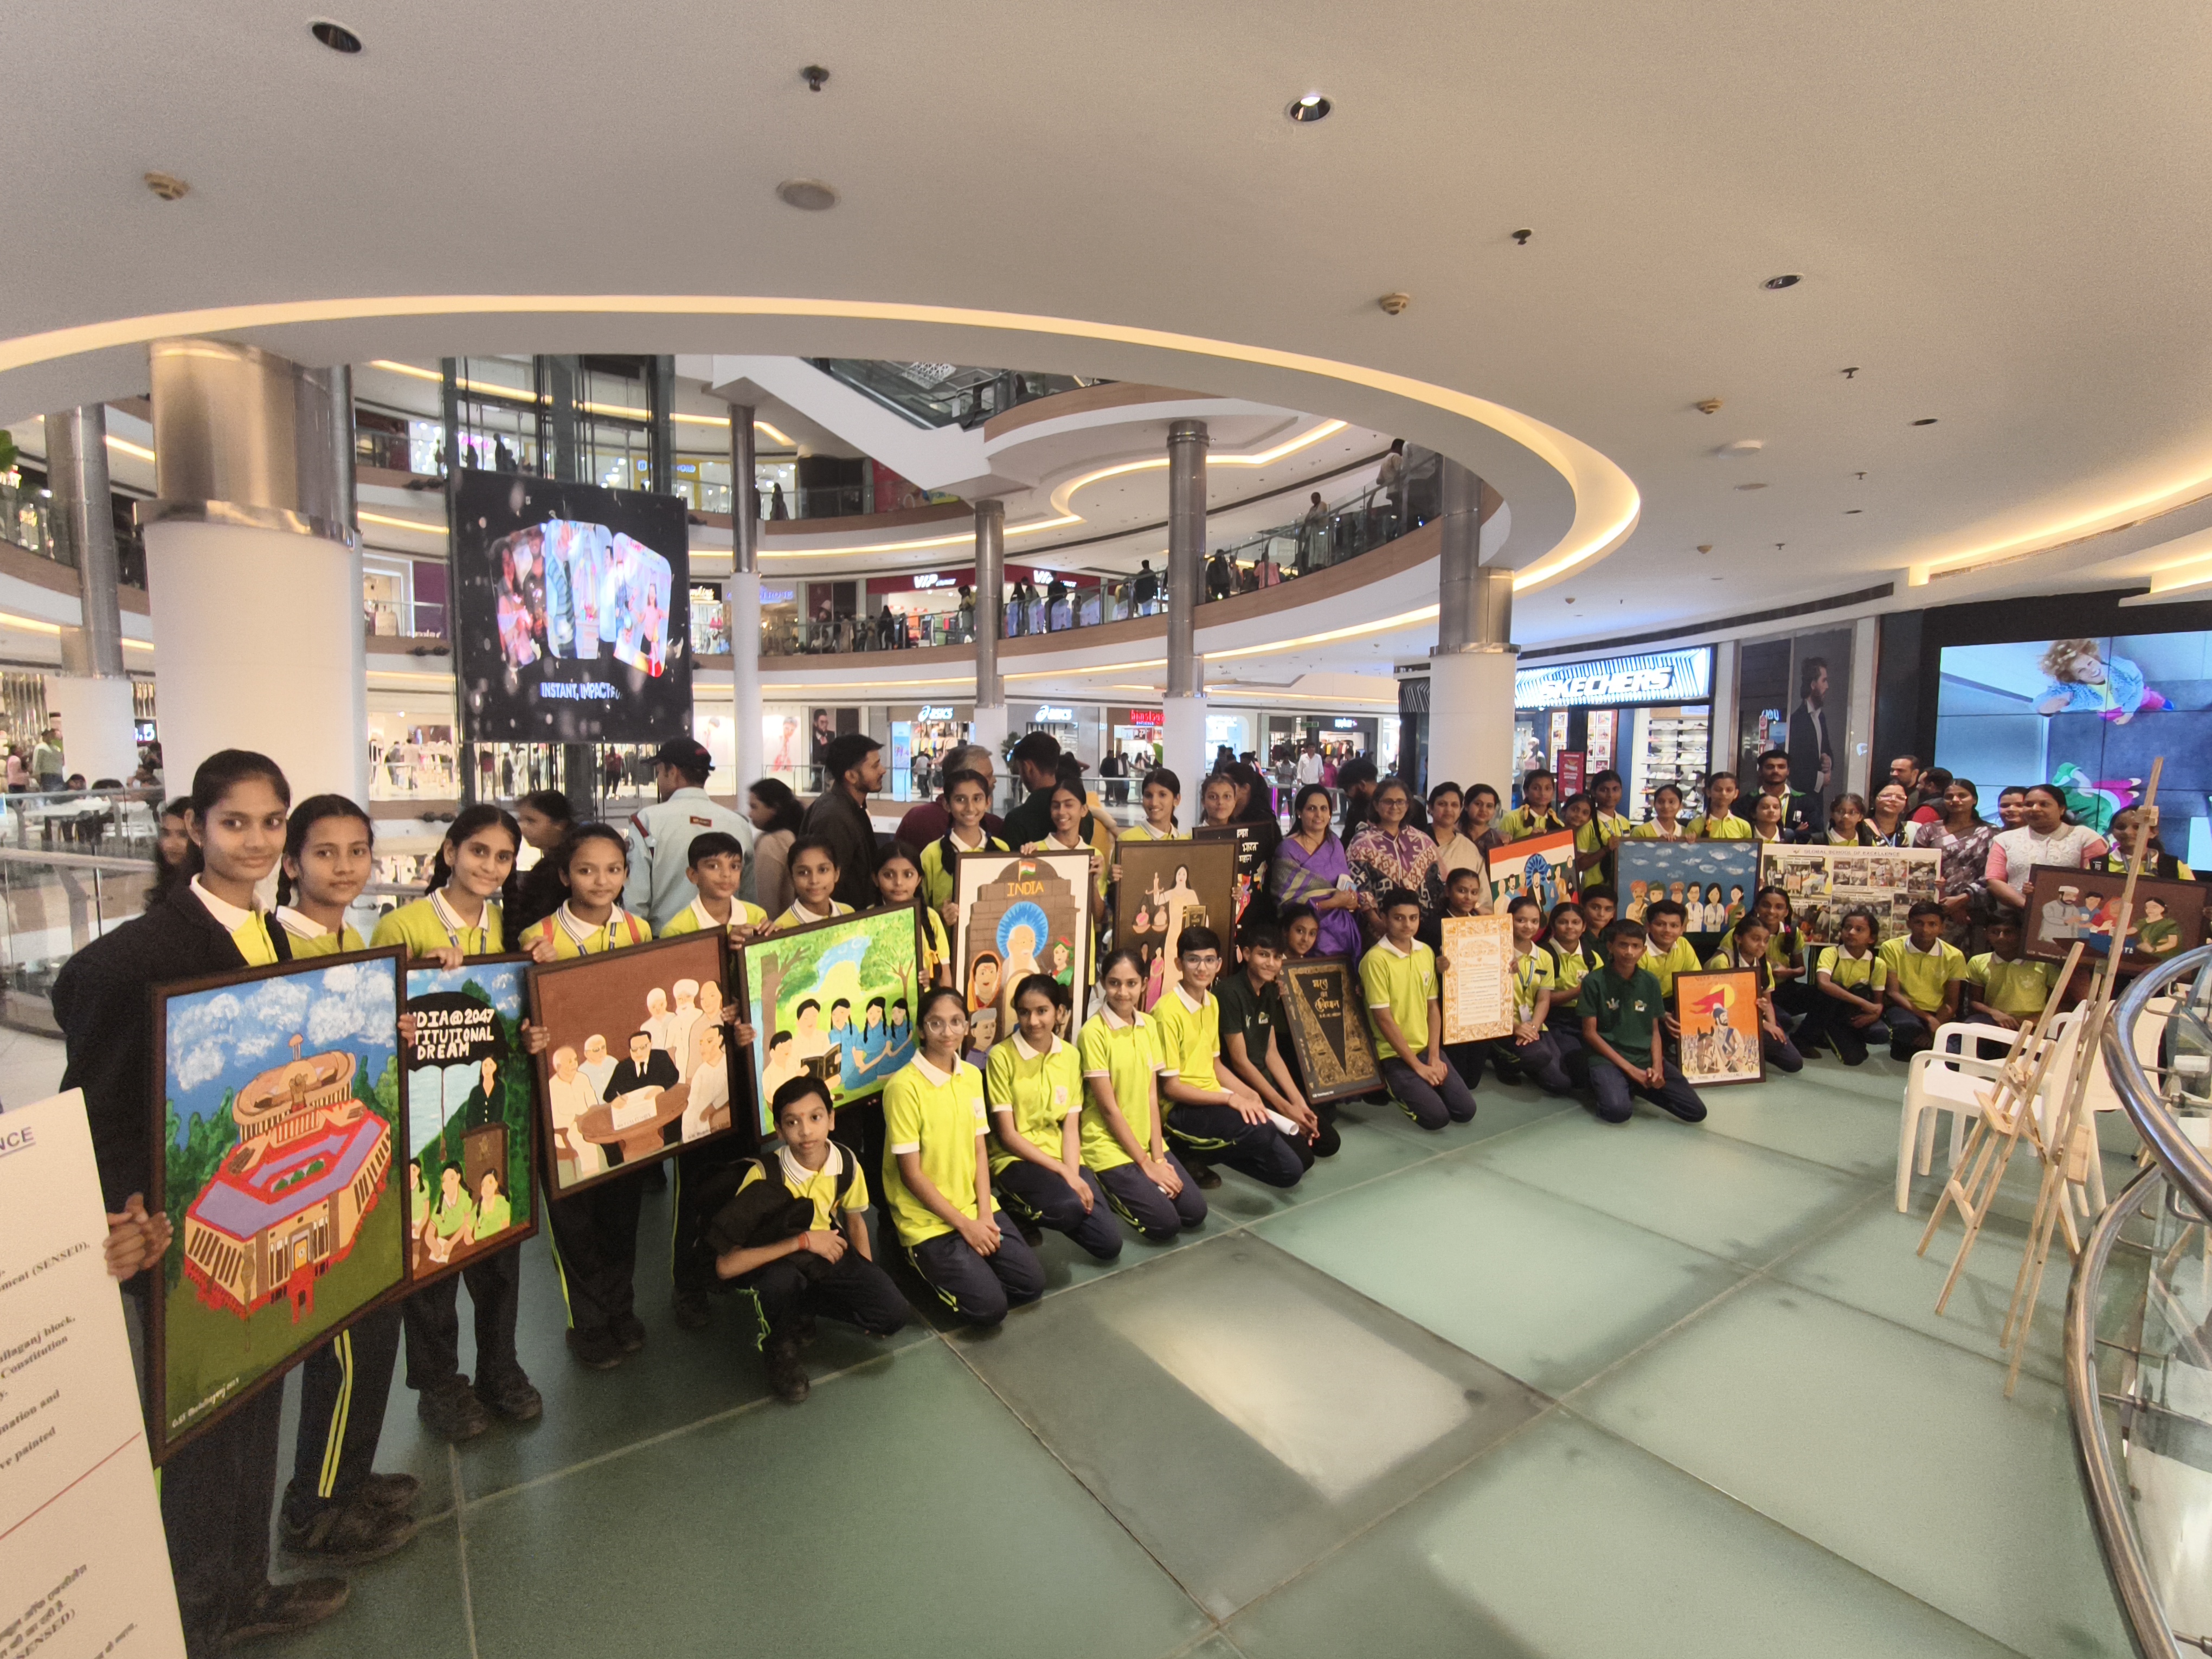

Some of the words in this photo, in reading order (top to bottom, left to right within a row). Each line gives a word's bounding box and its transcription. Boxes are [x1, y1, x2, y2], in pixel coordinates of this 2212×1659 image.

[914, 574, 938, 588] VIP
[541, 682, 579, 701] INSTANT,
[1540, 666, 1674, 699] SKECHERS
[1007, 880, 1044, 897] INDIA
[413, 1008, 494, 1027] DIA@2047
[417, 1042, 470, 1060] DREAM
[1, 1336, 68, 1378] Constitution
[40, 1389, 60, 1409] and
[15, 1426, 56, 1462] painted
